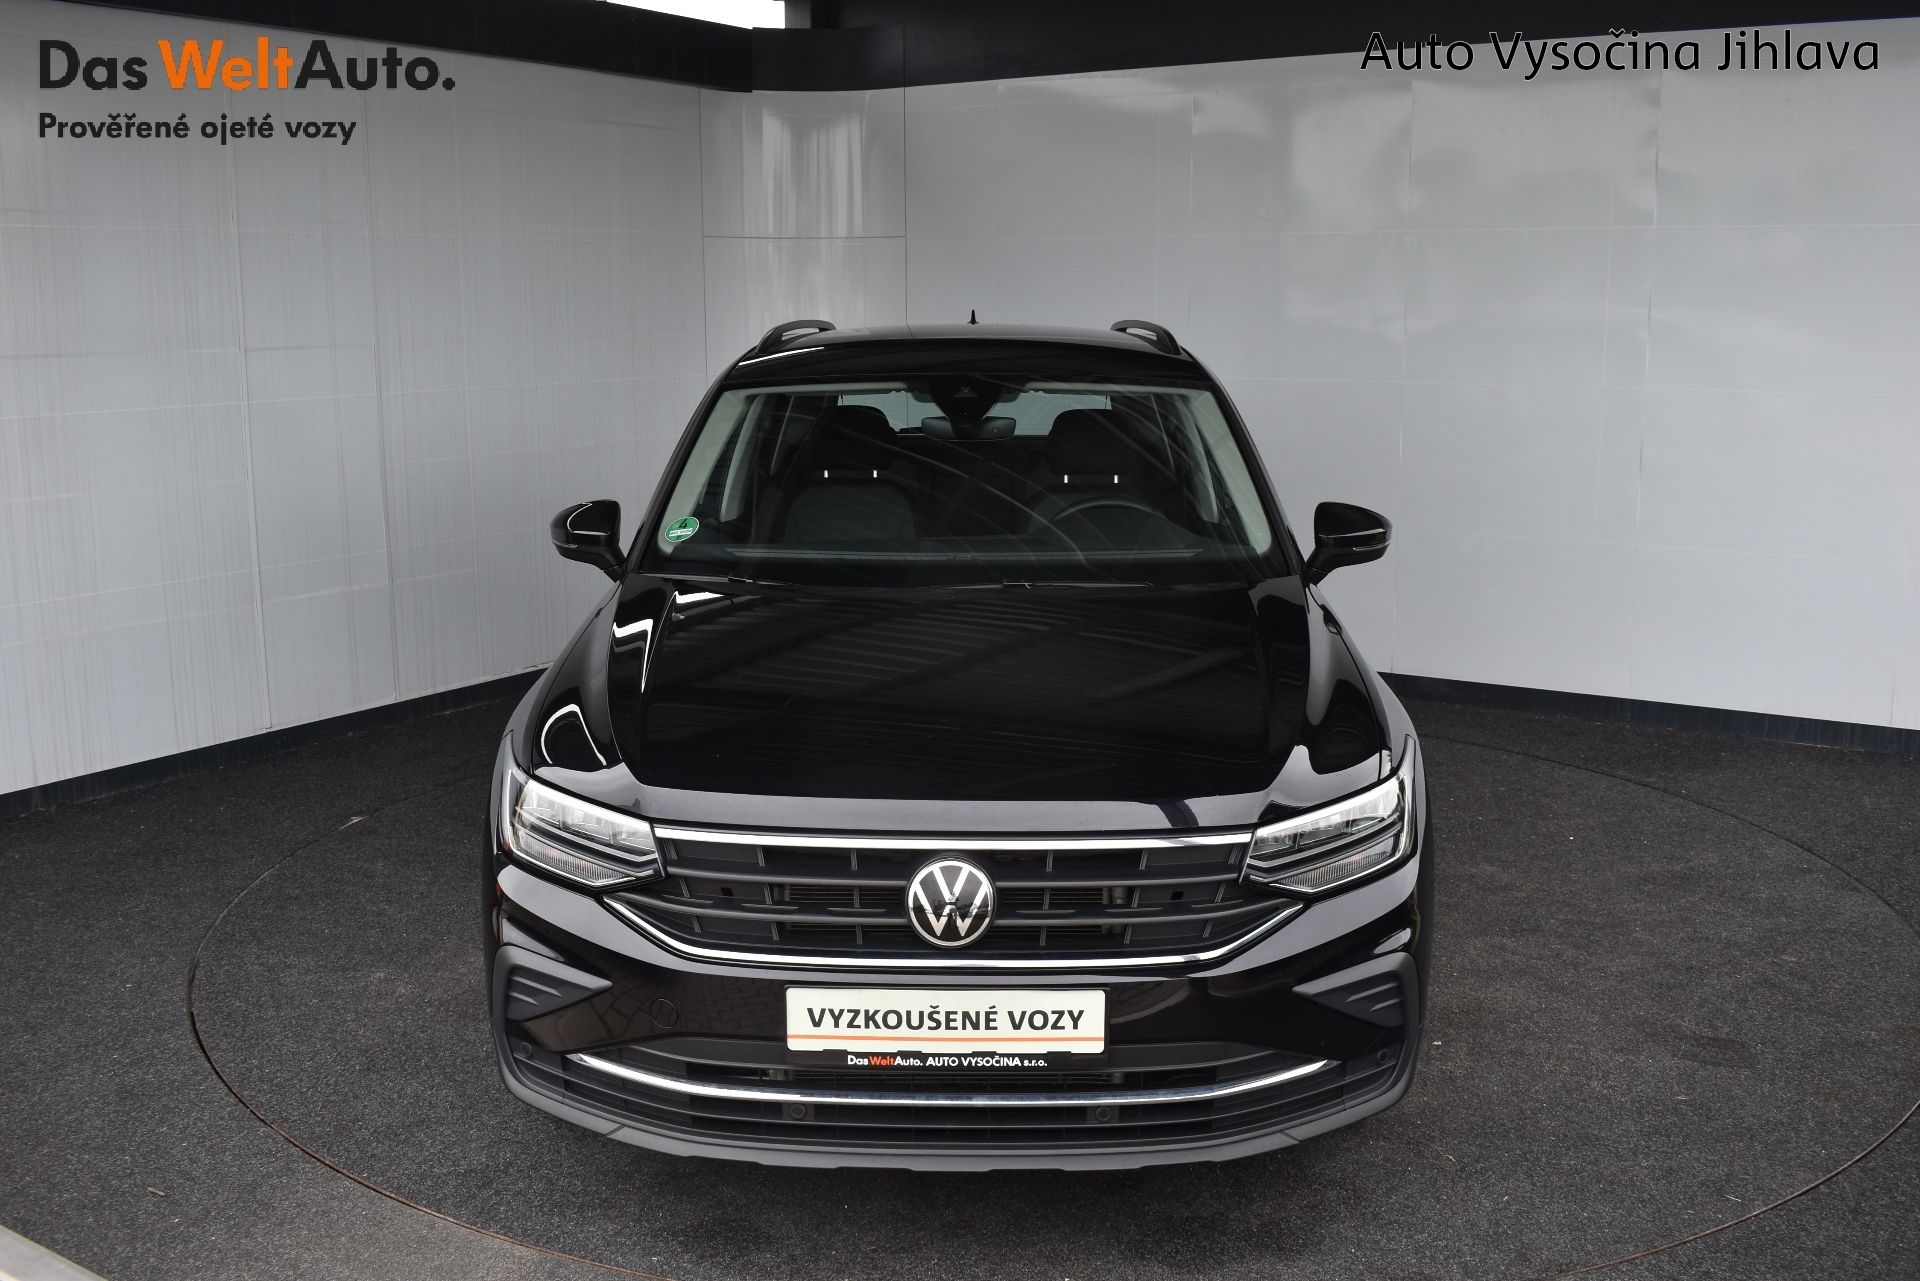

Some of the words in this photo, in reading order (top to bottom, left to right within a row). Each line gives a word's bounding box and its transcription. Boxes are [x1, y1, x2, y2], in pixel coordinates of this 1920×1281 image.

[806, 1005, 998, 1031] VYZKOUŠENÉ
[1007, 1010, 1085, 1031] VOZY
[925, 1056, 959, 1067] AUTO
[961, 1054, 1022, 1067] VYSOČINA
[1023, 1058, 1048, 1067] s.r.o.
